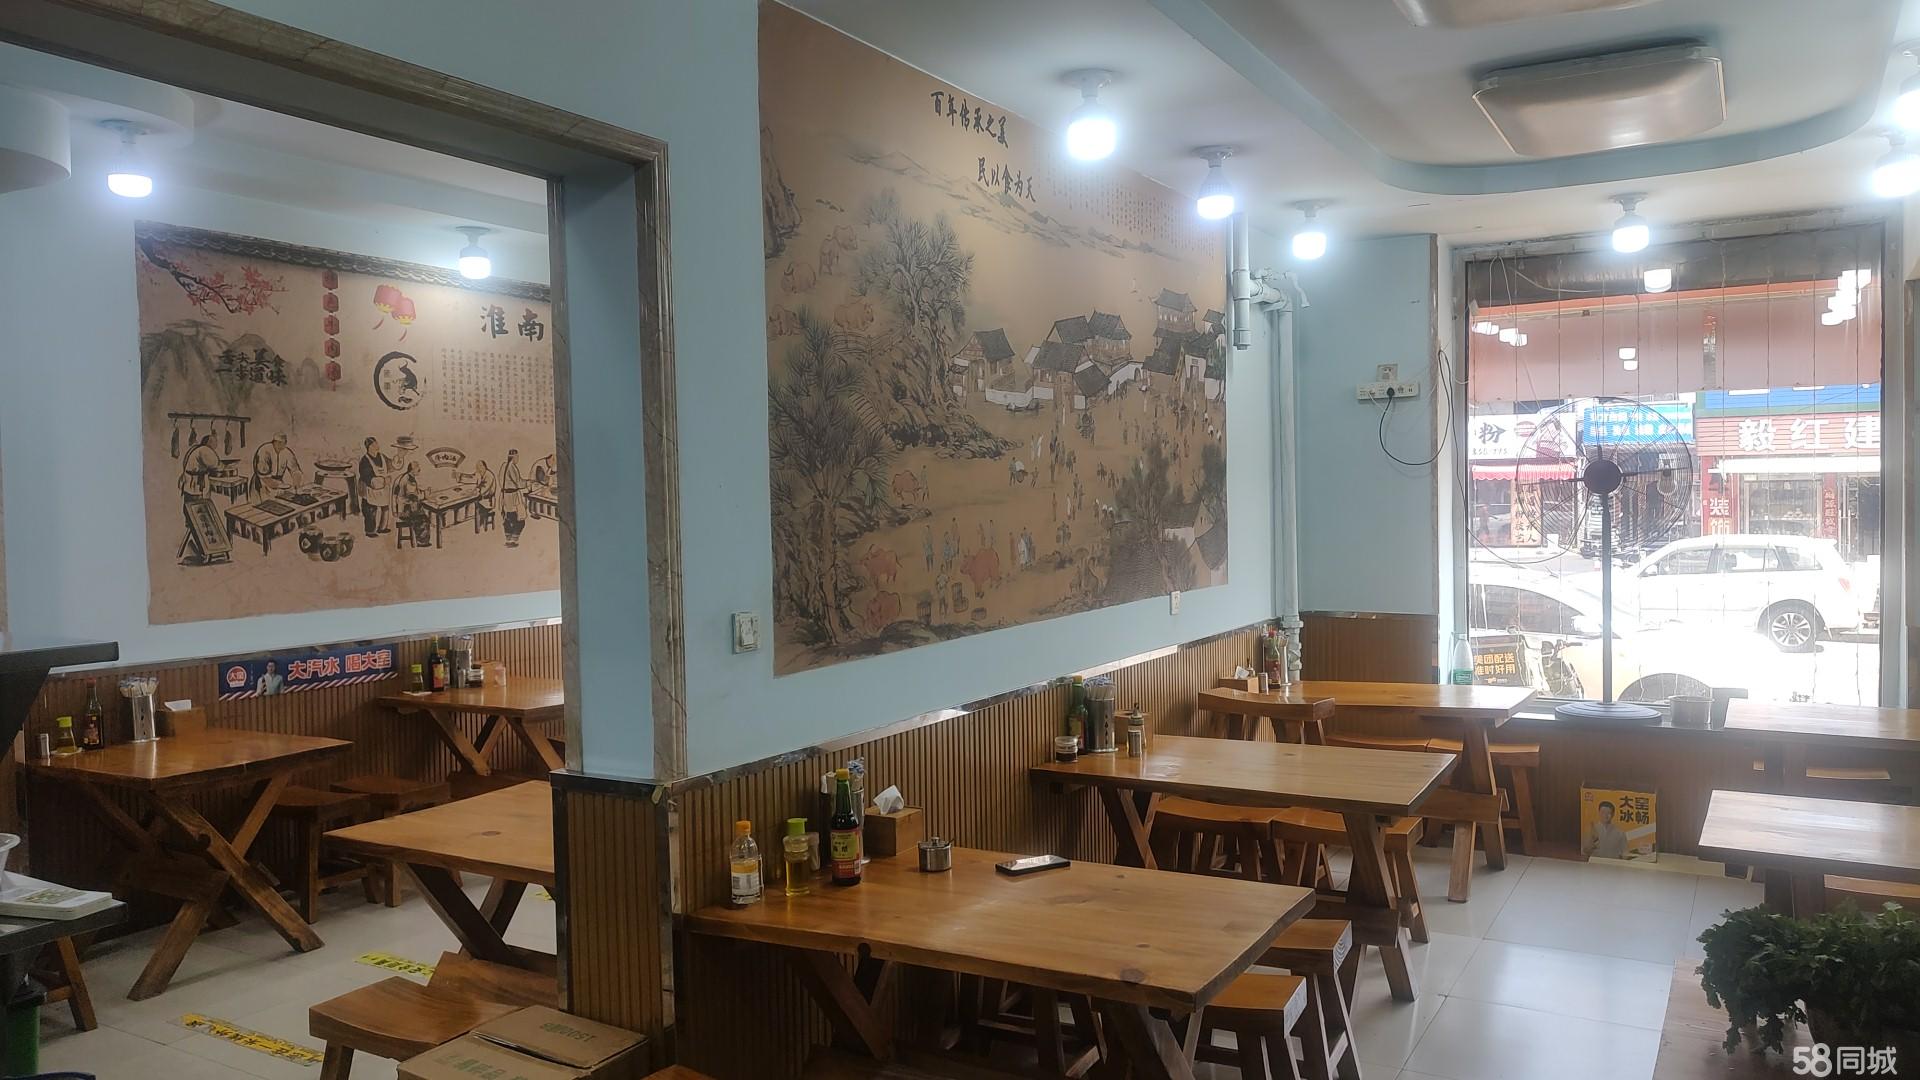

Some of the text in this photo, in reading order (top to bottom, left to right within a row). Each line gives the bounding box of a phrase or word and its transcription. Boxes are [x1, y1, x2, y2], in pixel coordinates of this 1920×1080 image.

[931, 91, 1008, 149] 百年传承之美
[977, 157, 1036, 202] 民以食为天
[480, 304, 544, 342] 淮南
[1478, 422, 1506, 445] 粉
[1738, 415, 1881, 452] 毅红建
[288, 657, 341, 681] 大汽水
[1475, 664, 1516, 676] 准时好用
